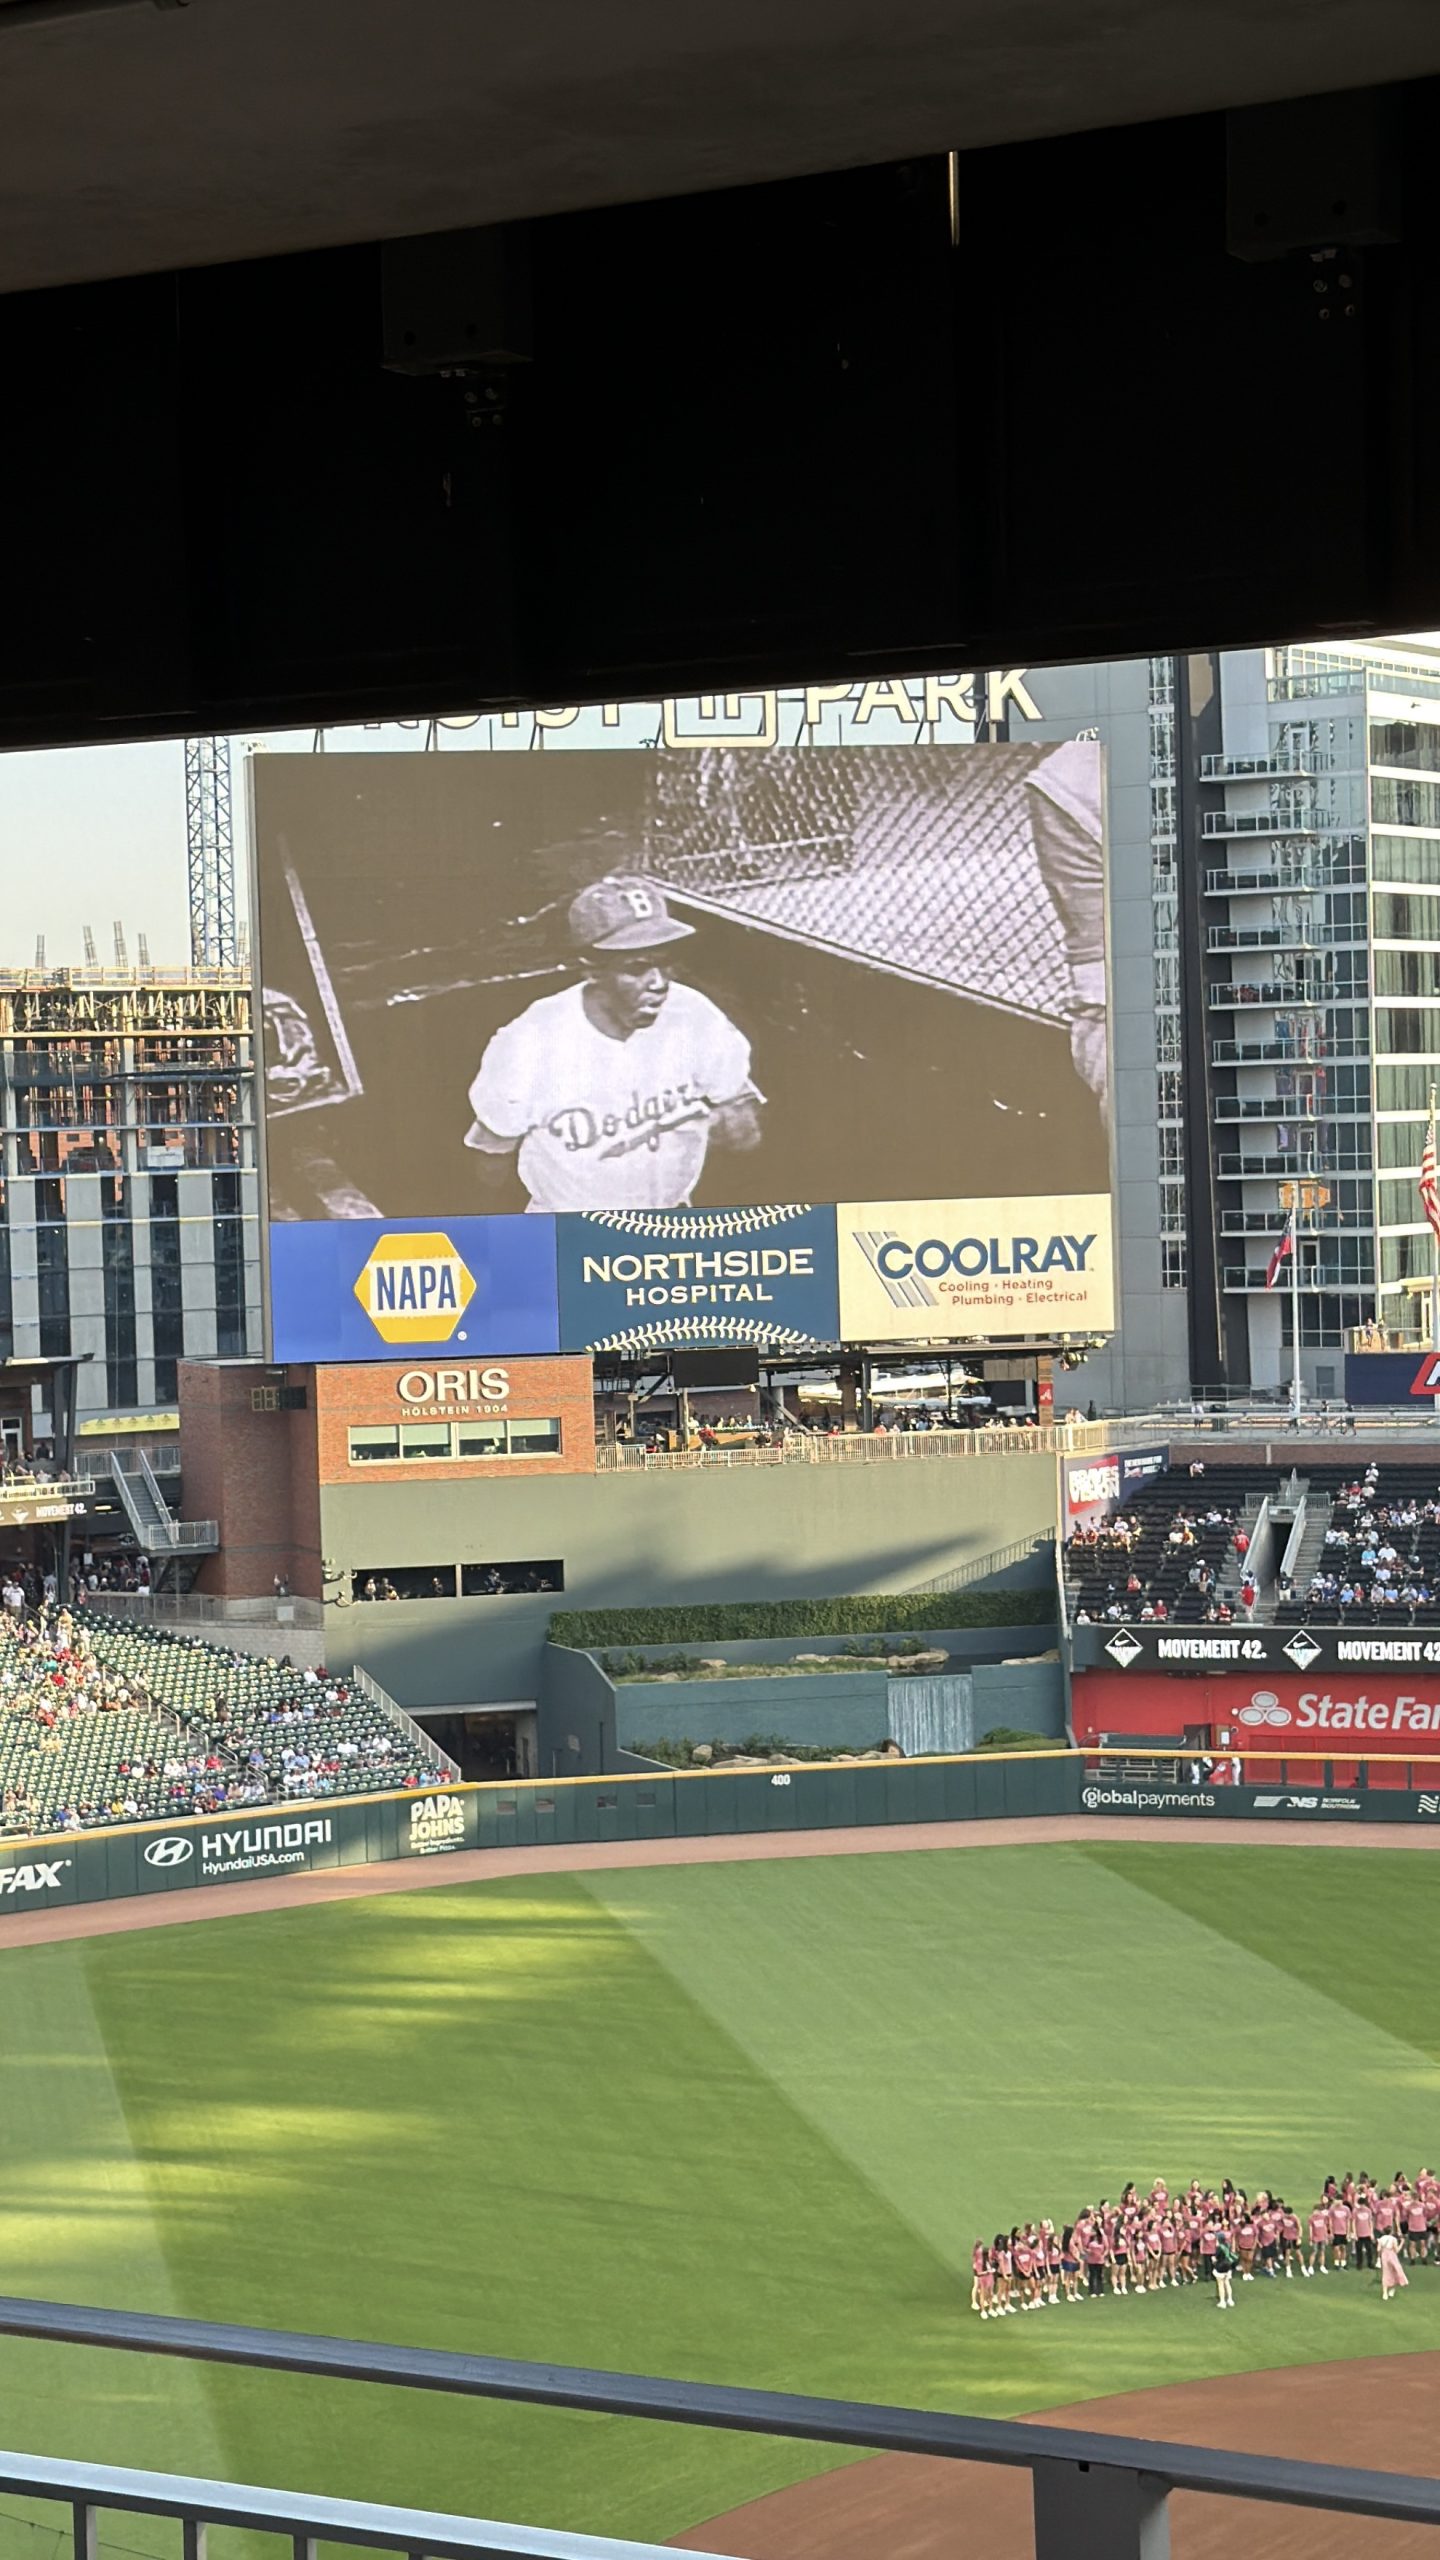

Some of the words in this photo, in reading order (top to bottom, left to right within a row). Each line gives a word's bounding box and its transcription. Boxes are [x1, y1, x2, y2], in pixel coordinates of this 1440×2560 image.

[628, 889, 653, 919] B
[583, 1248, 814, 1283] NORTHSIDE
[877, 1234, 1098, 1280] COOLRAY
[376, 1264, 457, 1311] NAPA
[626, 1283, 773, 1306] HOSPITAL
[938, 1281, 989, 1293] Cooling
[1002, 1279, 1053, 1291] Heating
[952, 1294, 1014, 1306] Plumbing
[1026, 1290, 1088, 1303] Electrical
[398, 1367, 510, 1402] ORIS
[476, 1404, 508, 1413] 1904
[1158, 1638, 1241, 1659] MOVEMENT
[1241, 1640, 1267, 1659] 42.
[1337, 1641, 1423, 1661] MOVEMENT
[771, 1773, 791, 1786] 400
[411, 1795, 464, 1822] PAPA
[202, 1819, 332, 1858] HYUNDAI
[409, 1816, 465, 1840] JOHNS
[203, 1851, 304, 1875] HyundaiUSA.com
